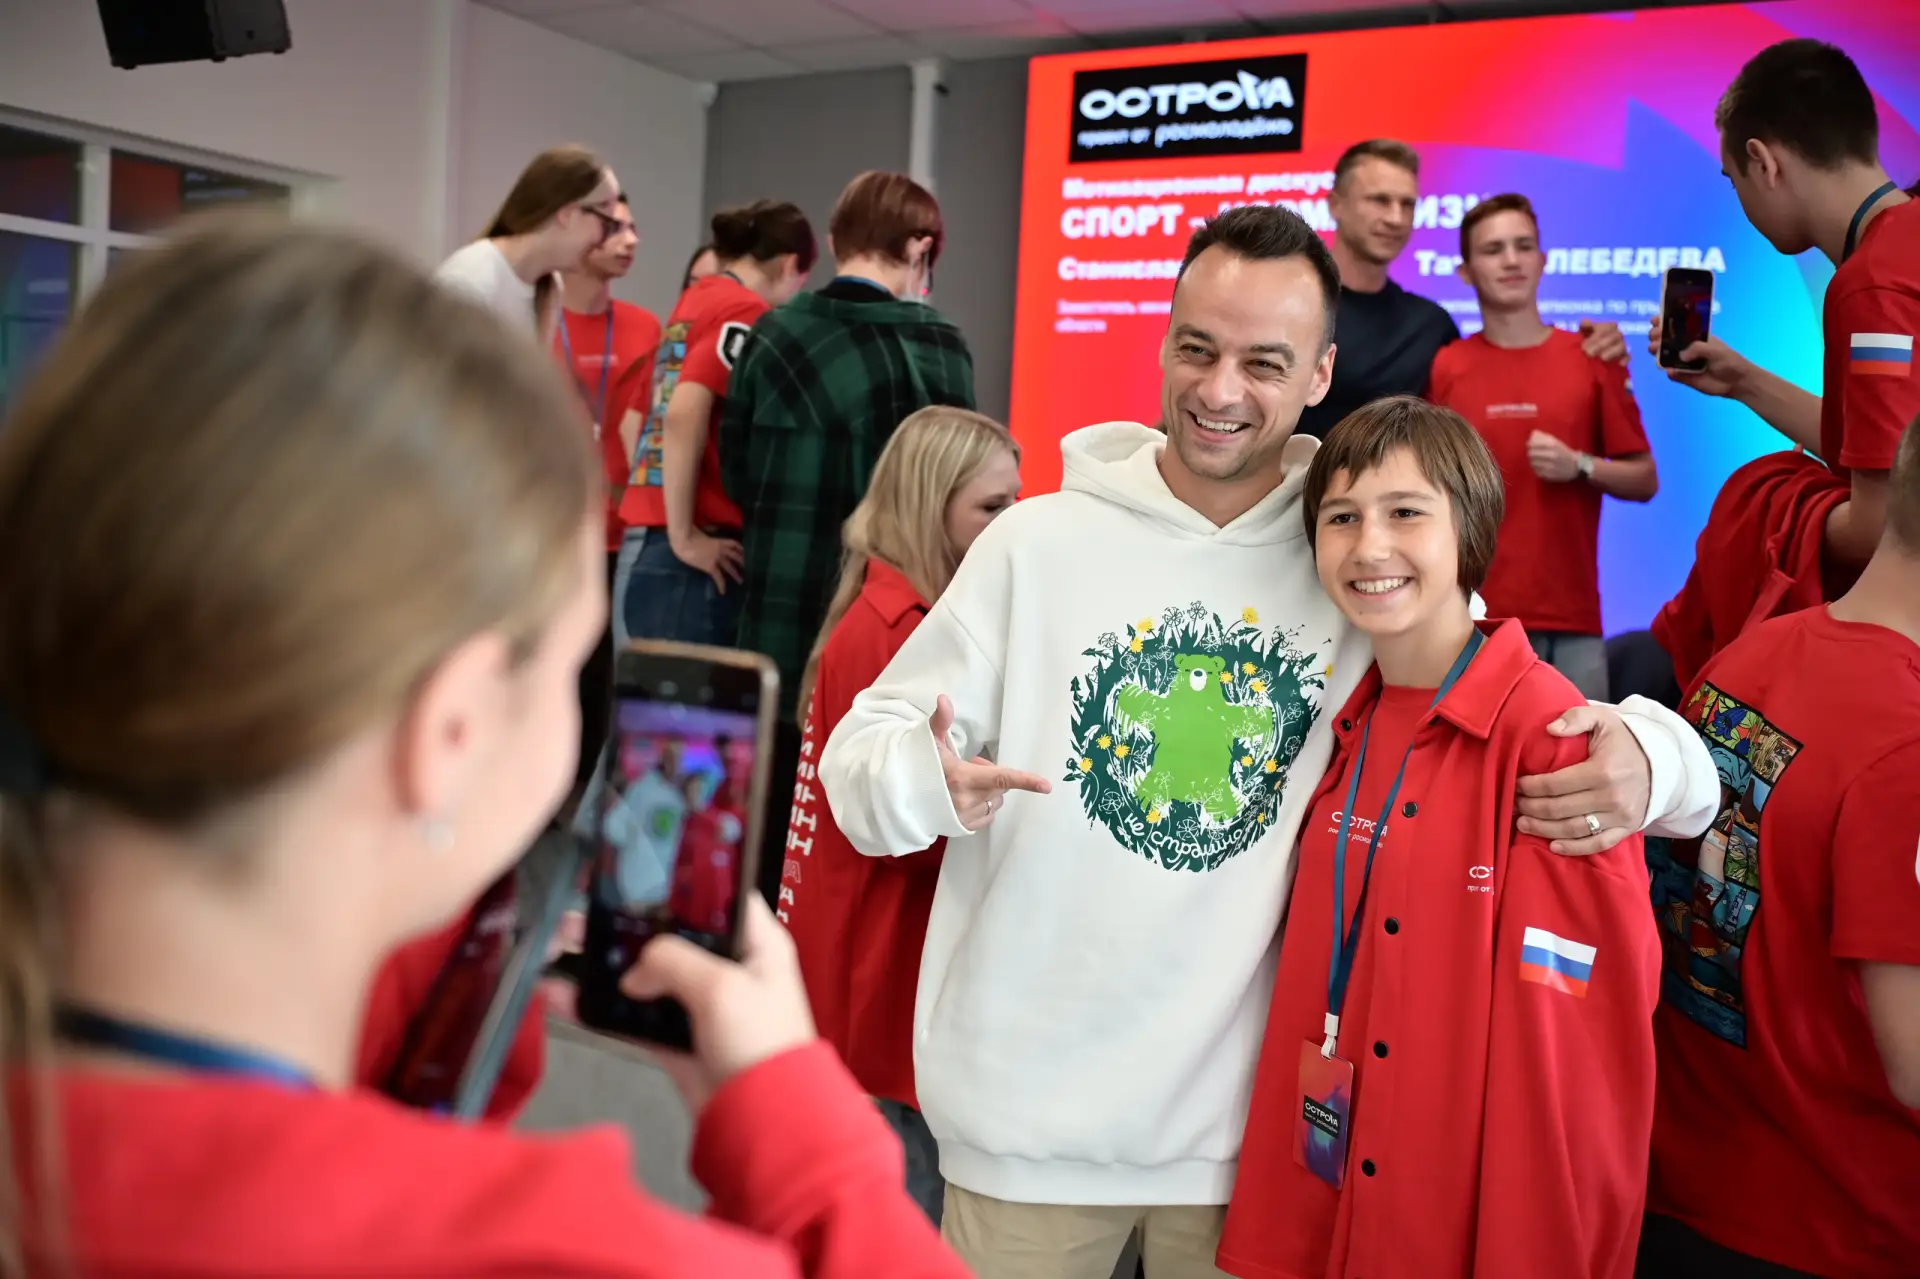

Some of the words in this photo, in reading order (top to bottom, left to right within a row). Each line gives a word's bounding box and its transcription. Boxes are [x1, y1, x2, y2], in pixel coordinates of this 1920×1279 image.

[1060, 204, 1184, 239] СПОРТ
[1543, 246, 1726, 278] ЛЕБЕДЕВА
[1151, 828, 1243, 864] страшно
